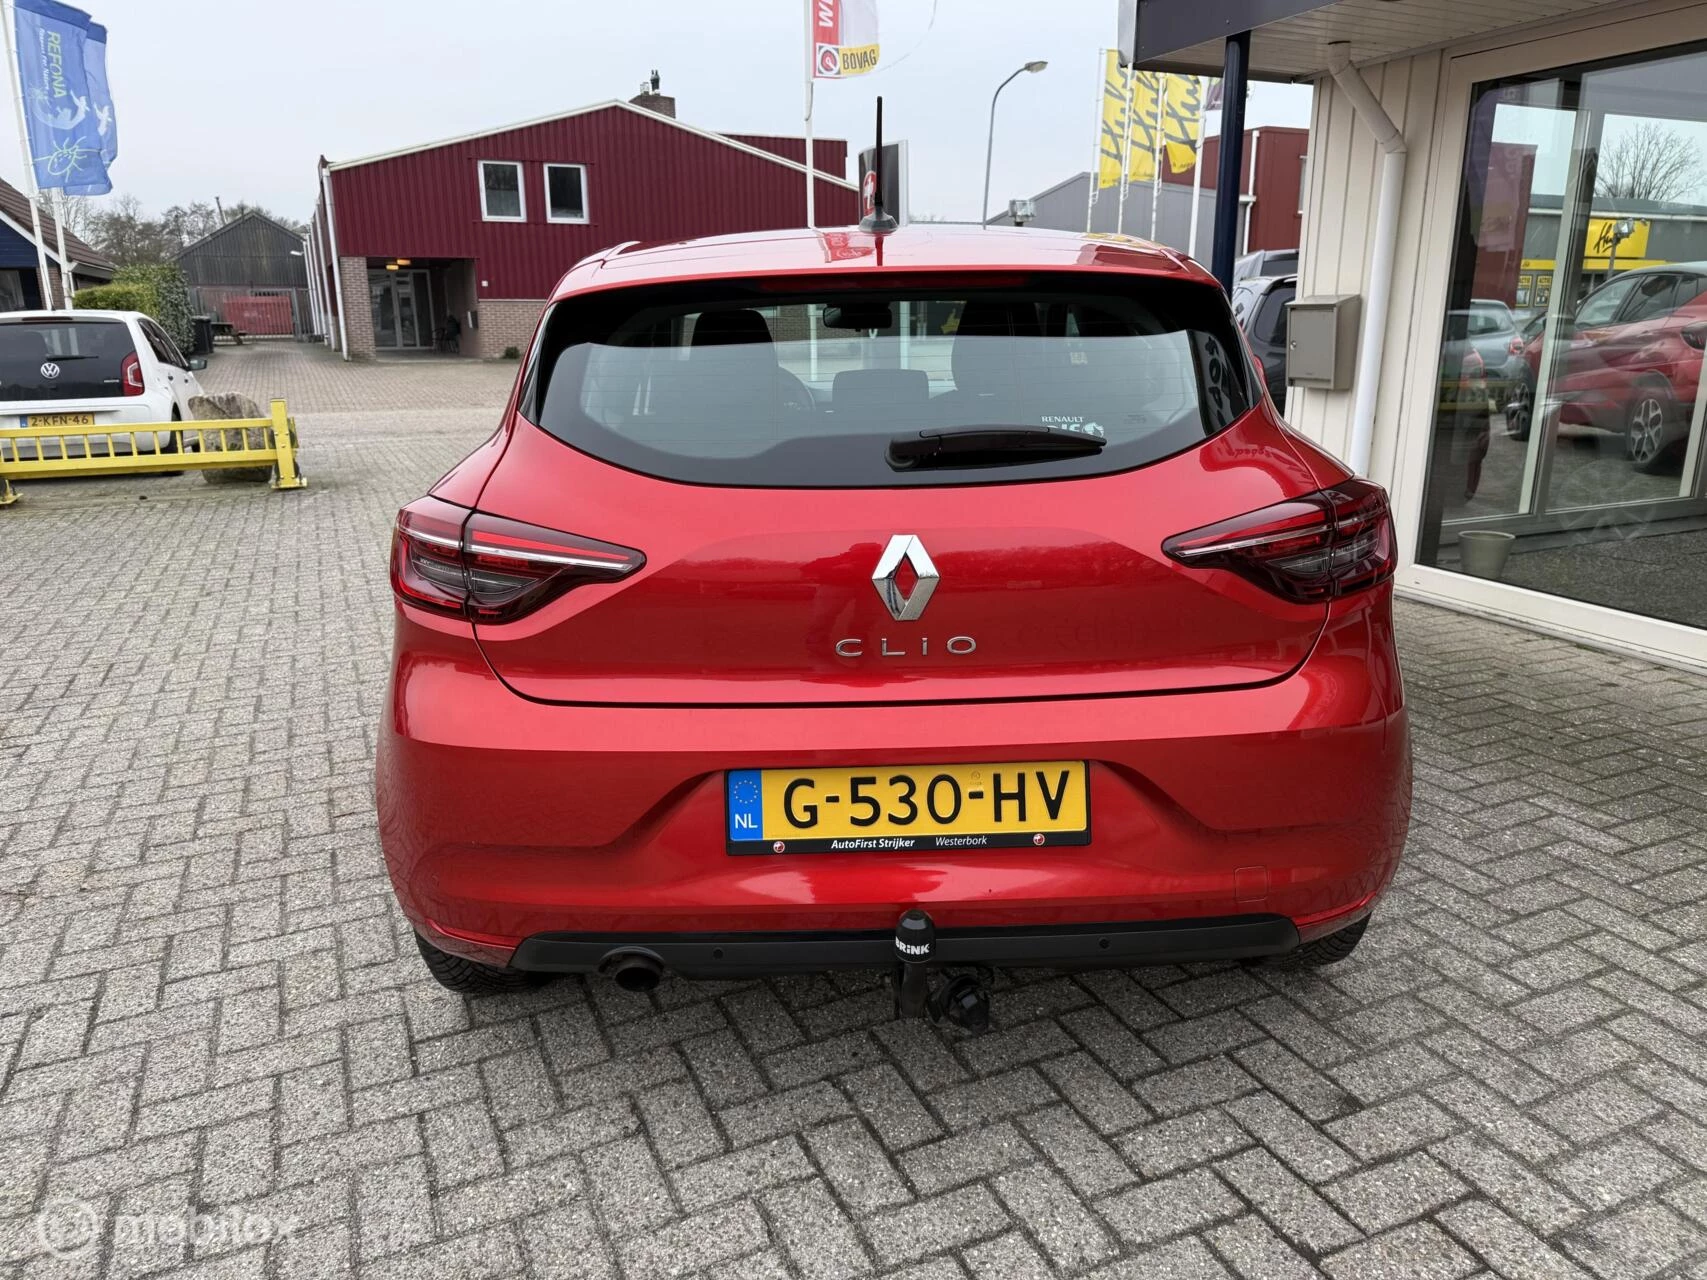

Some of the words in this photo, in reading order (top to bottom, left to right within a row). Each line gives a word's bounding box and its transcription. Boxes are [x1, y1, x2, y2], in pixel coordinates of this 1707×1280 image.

[46, 30, 67, 98] REFONA
[842, 48, 877, 70] BOVAG
[31, 415, 89, 427] 2-KFN-46
[1041, 415, 1084, 423] RENAULT
[783, 770, 1070, 829] G-530-HV
[734, 813, 758, 829] NL
[831, 838, 877, 850] AutoFirst
[879, 838, 916, 850] Strijker
[935, 836, 988, 847] Westerbork
